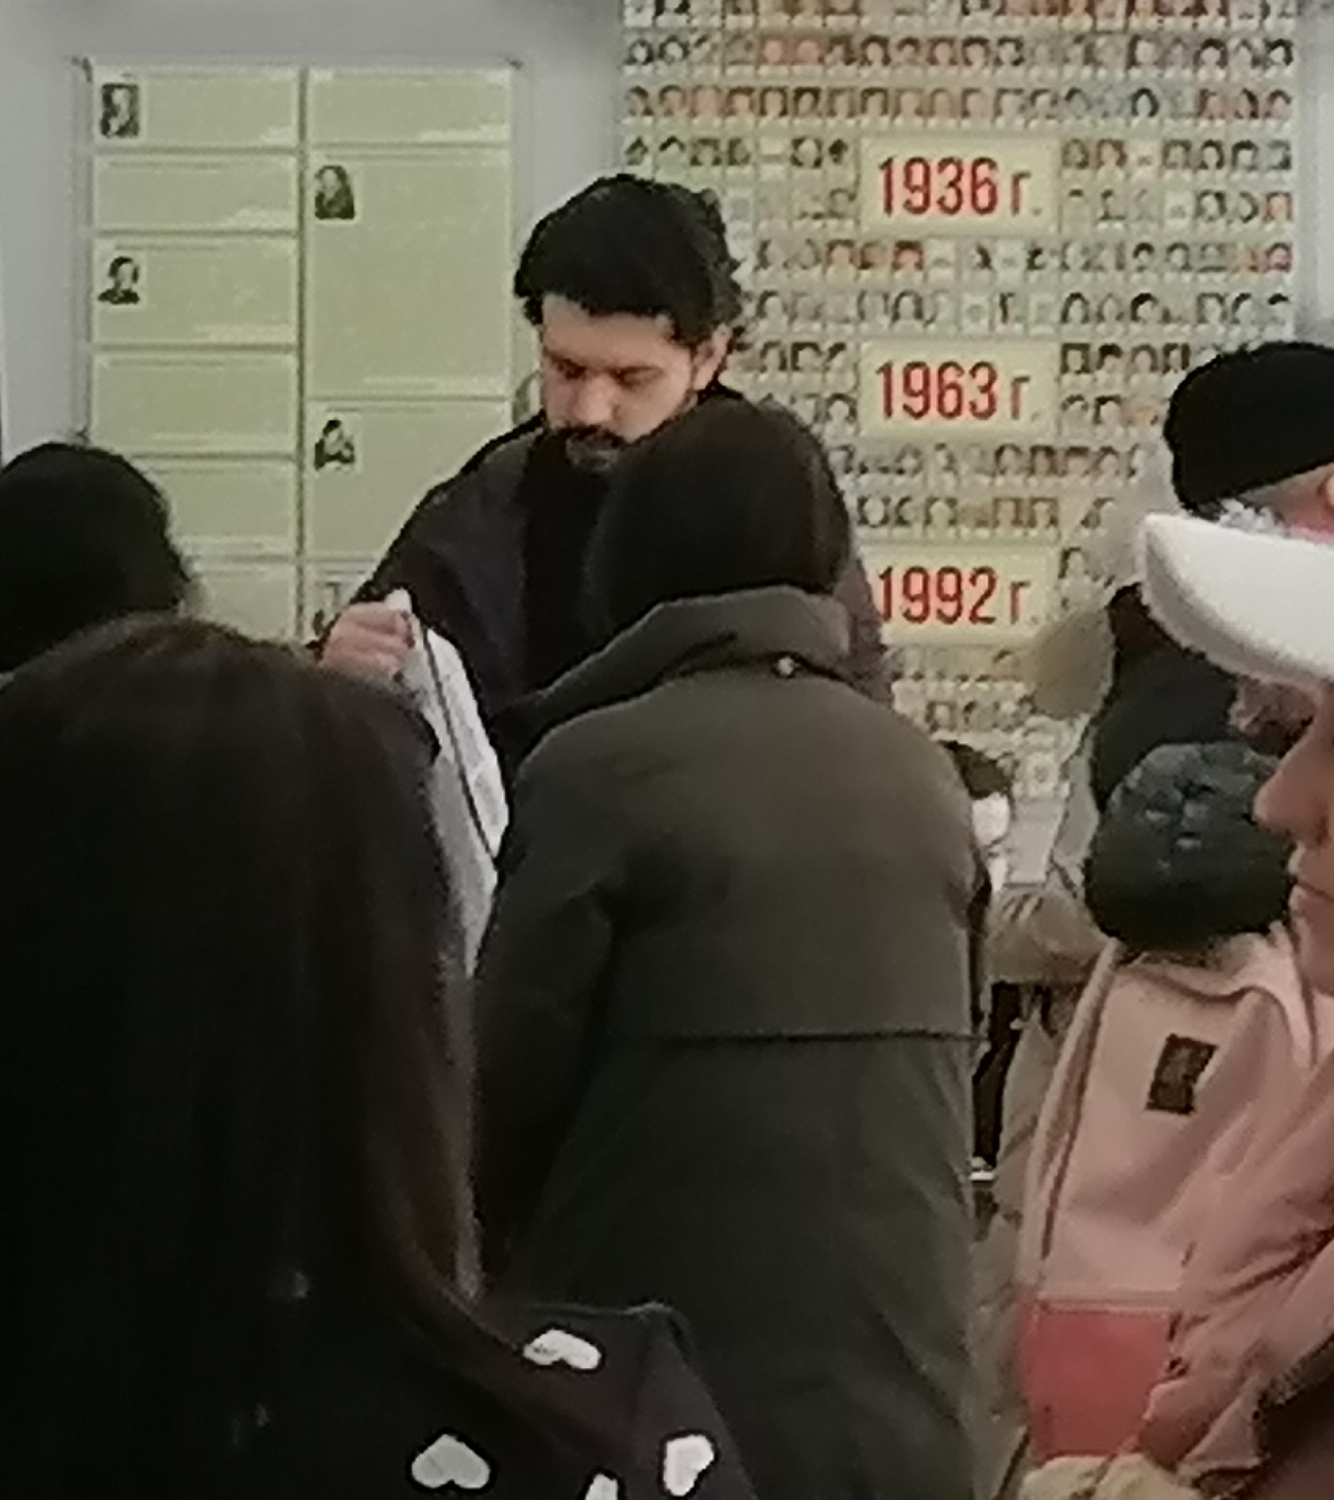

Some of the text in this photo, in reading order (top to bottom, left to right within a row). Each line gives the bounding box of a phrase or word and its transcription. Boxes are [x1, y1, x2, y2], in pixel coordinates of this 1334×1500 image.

[878, 156, 999, 216] 1936
[875, 360, 999, 421] 1963
[878, 565, 998, 626] 1992
